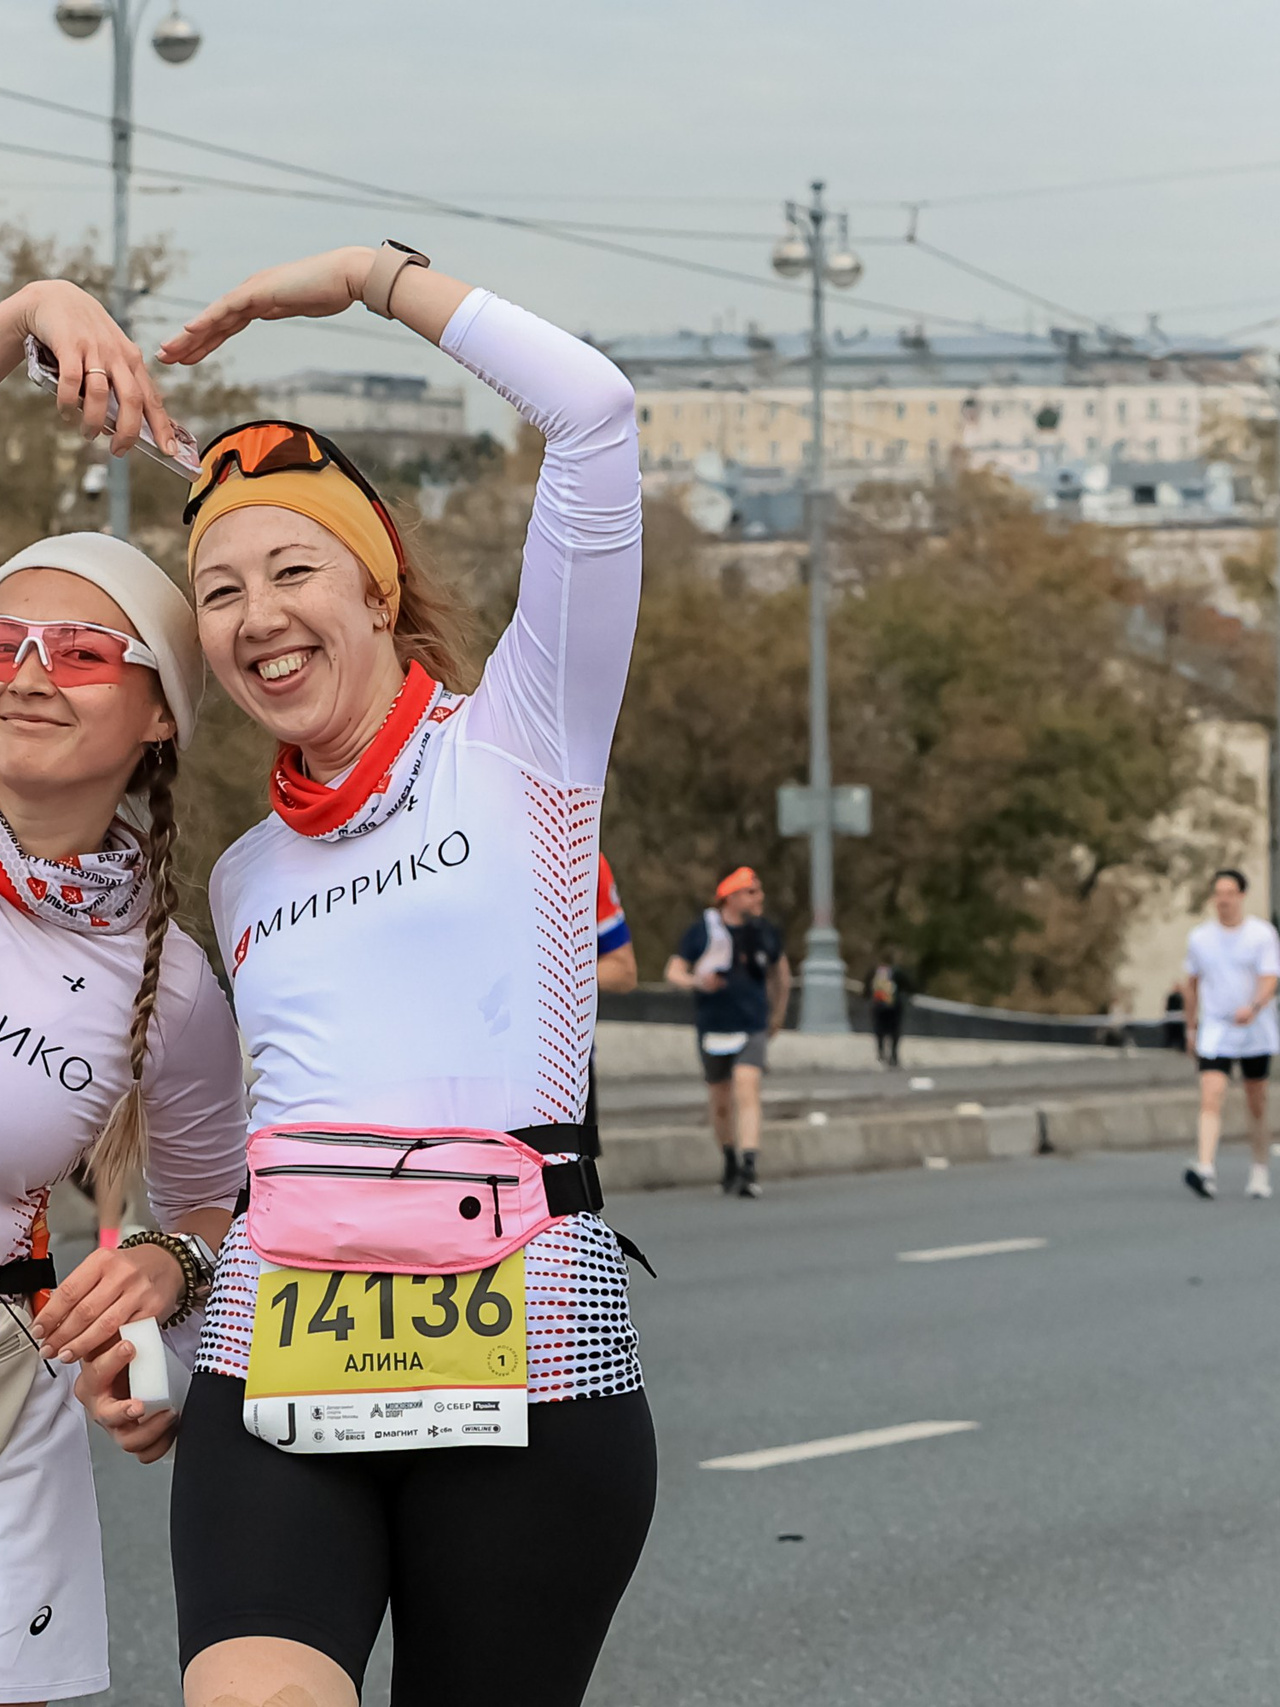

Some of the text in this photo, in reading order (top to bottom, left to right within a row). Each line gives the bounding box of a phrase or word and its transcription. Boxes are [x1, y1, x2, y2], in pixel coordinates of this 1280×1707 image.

[255, 830, 470, 944] МИРРИКО
[270, 1261, 513, 1348] 14136
[344, 1351, 424, 1373] АЛИНА
[497, 1354, 505, 1367] 1
[447, 1402, 471, 1411] СБЕР
[277, 1402, 297, 1446] J
